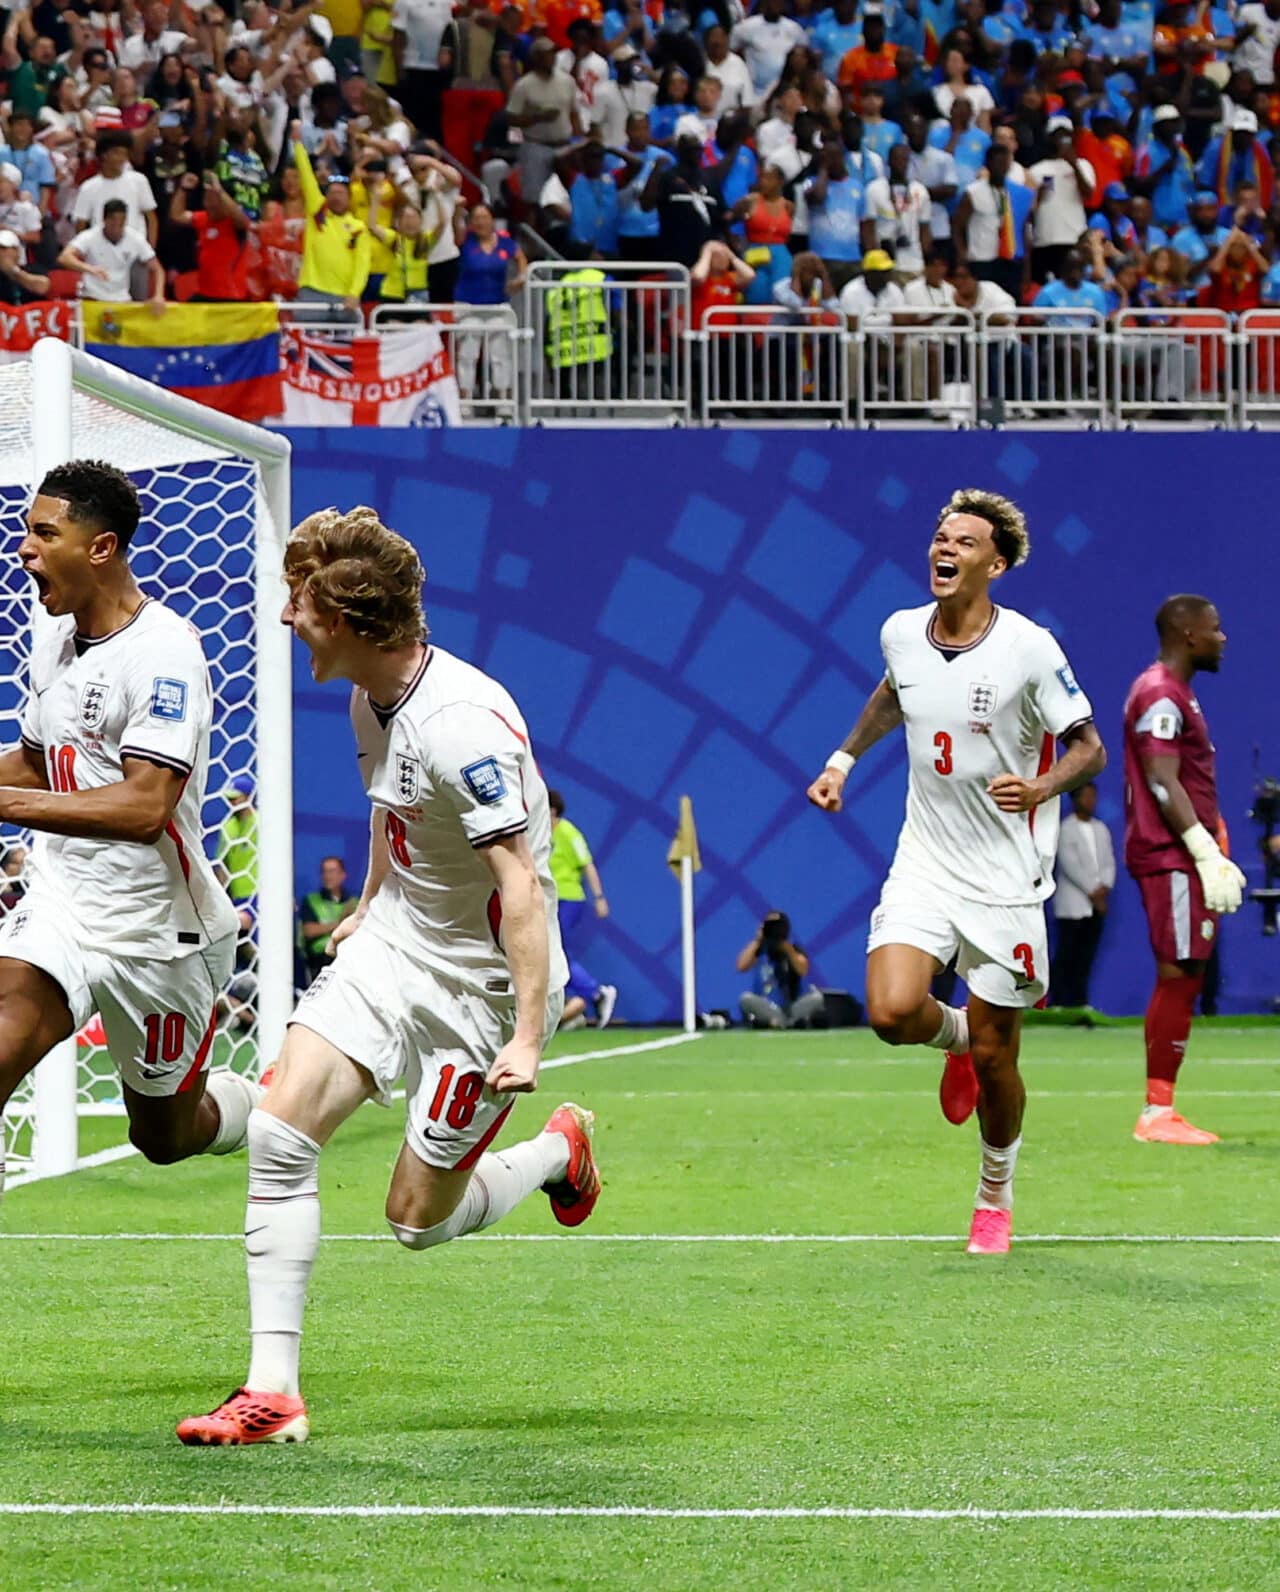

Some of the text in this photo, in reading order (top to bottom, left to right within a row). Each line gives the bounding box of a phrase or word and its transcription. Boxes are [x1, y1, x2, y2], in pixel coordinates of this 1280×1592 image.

[49, 744, 78, 793] 10
[934, 731, 953, 776] 3
[385, 810, 412, 869] 8
[1013, 943, 1035, 983] 3
[143, 1012, 186, 1065] 10
[428, 1063, 485, 1130] 18
